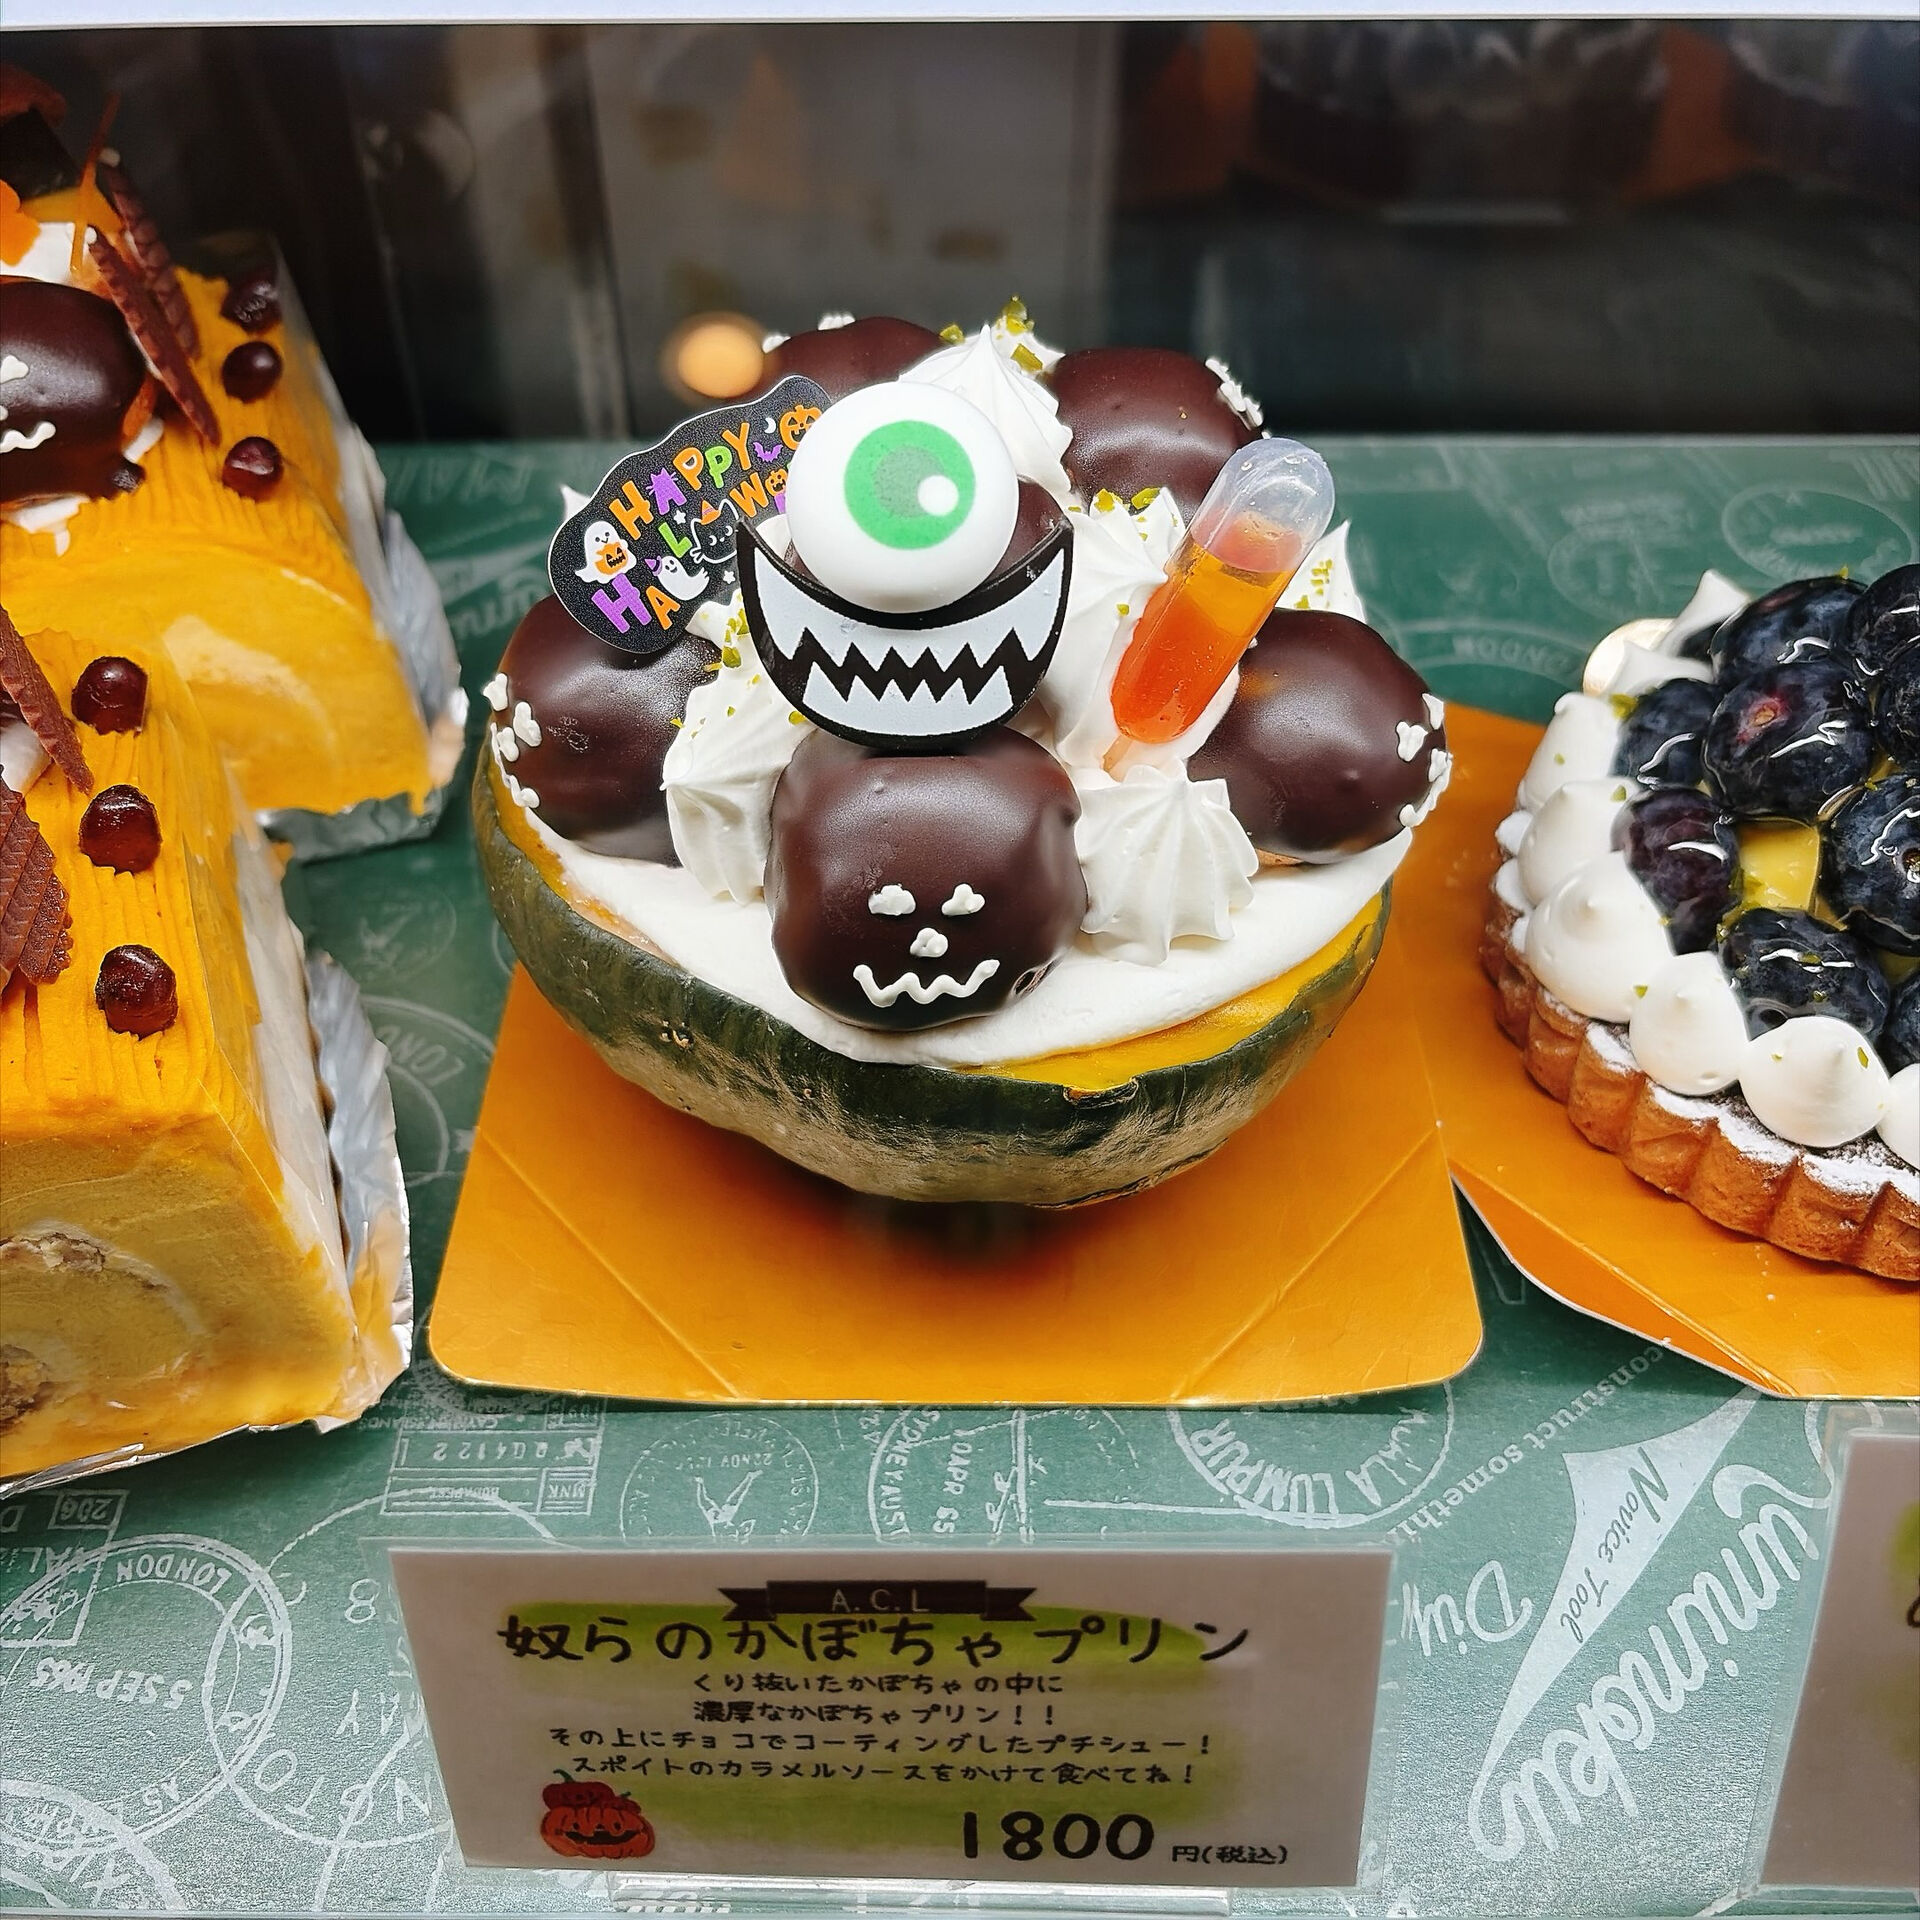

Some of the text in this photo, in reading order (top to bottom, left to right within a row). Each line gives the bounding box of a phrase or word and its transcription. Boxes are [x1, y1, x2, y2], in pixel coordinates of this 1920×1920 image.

[607, 421, 751, 541] HAPPY
[1521, 1345, 1664, 1453] construct
[1191, 1419, 1340, 1516] LUMPUR
[116, 1552, 232, 1596] LONDON
[498, 1614, 1249, 1668] 奴らのかぼちゃプリン
[97, 1669, 167, 1704] SEP
[693, 1672, 1064, 1696] くり抜いたかぼちゃの中に
[963, 1810, 1155, 1862] 1800
